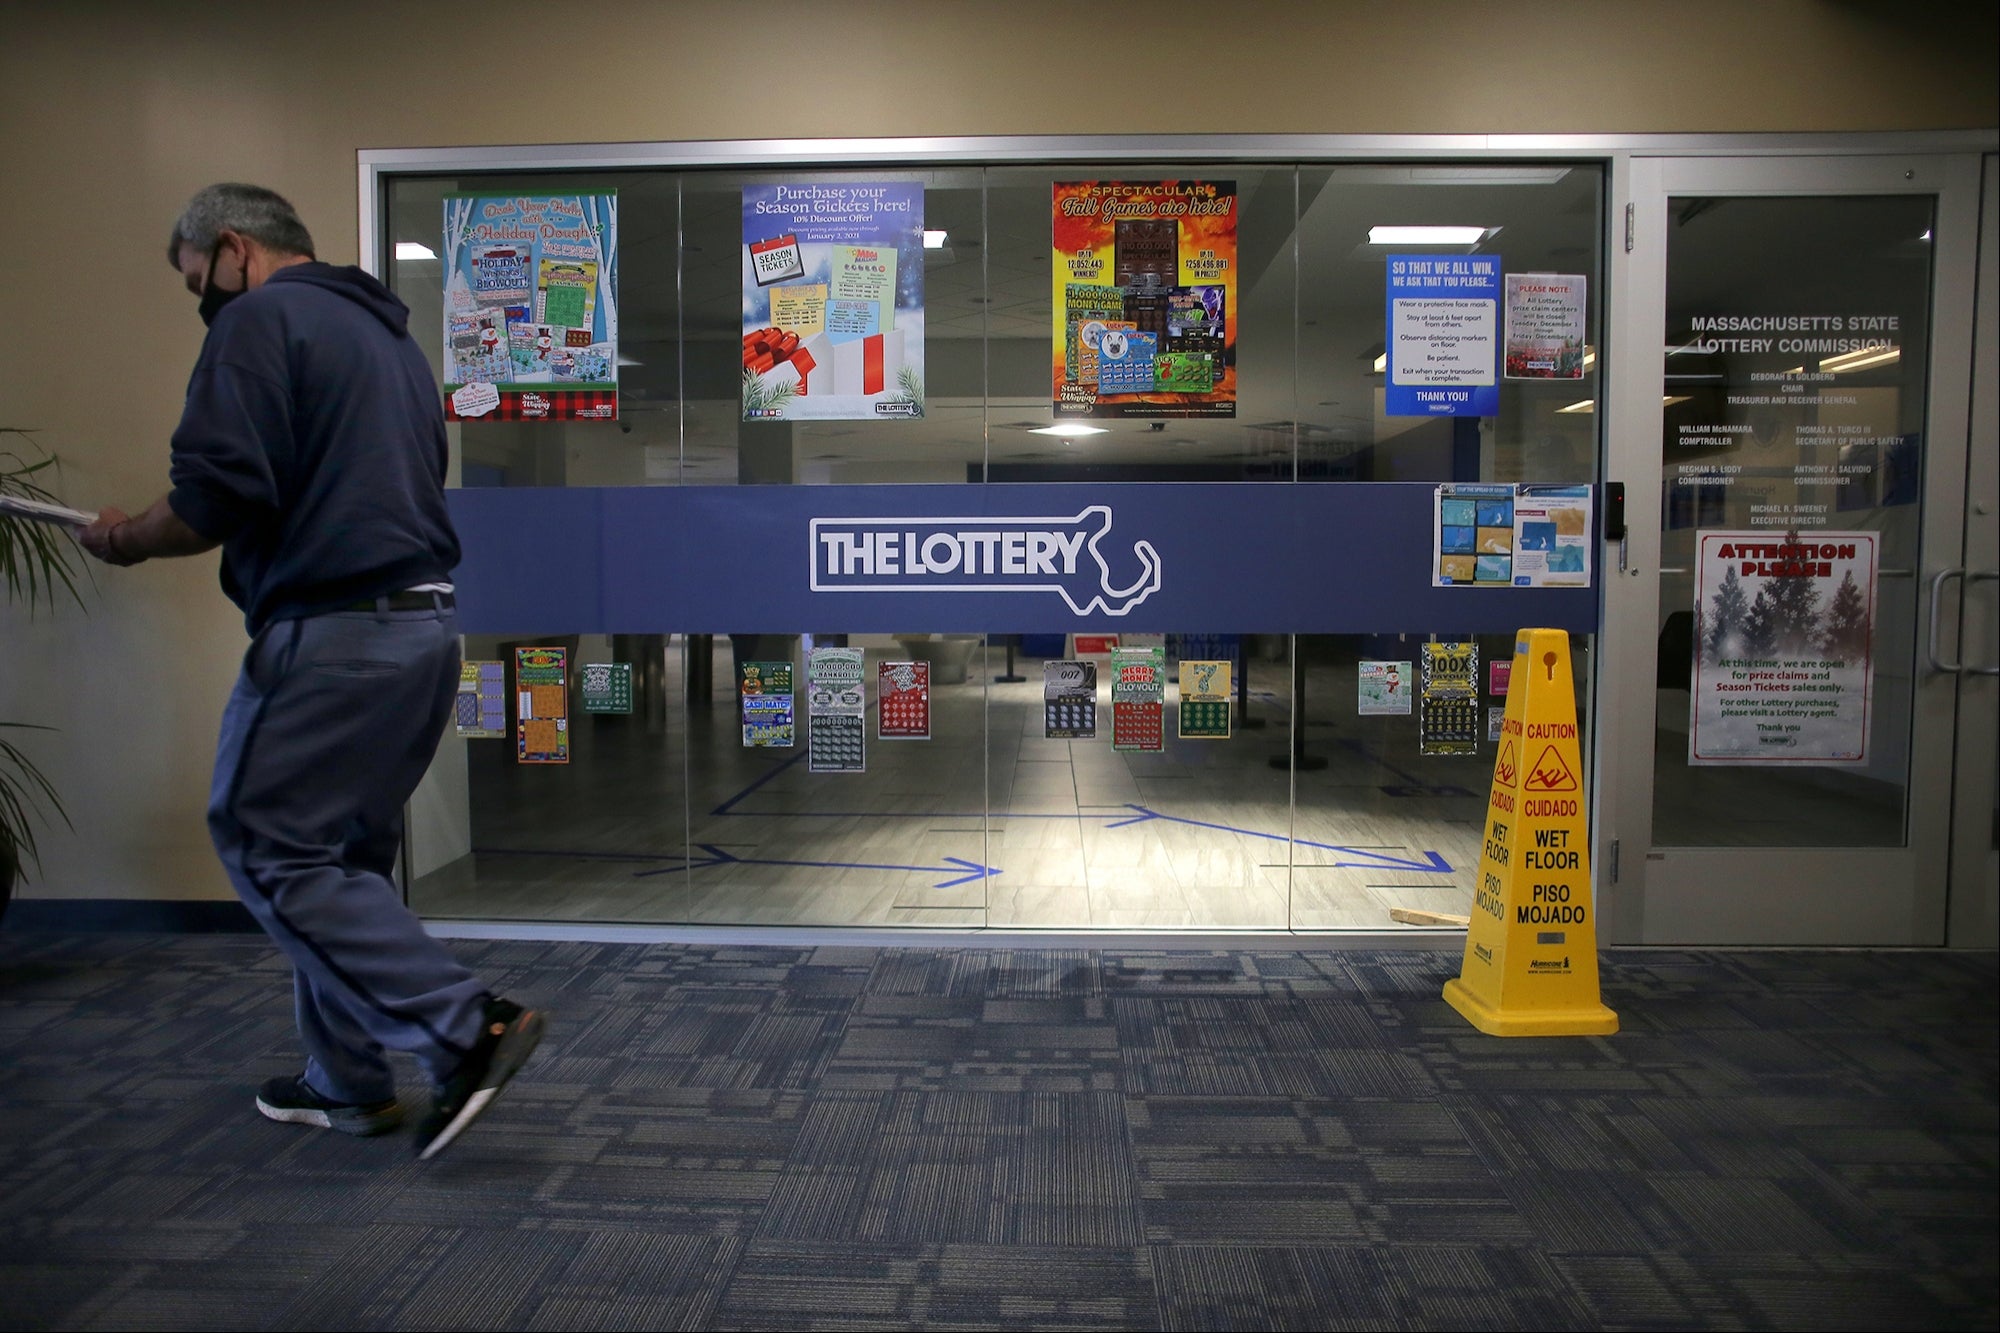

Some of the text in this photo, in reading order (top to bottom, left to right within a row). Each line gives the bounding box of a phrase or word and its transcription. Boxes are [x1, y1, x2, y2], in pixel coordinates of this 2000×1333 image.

[774, 186, 887, 203] Purchase your
[1093, 187, 1205, 196] SPECTACULAR
[756, 199, 911, 214] Season Tickets here!
[1062, 196, 1232, 224] Fall Games are here!
[811, 215, 847, 223] Discount
[478, 224, 590, 244] Holiday Dough
[479, 256, 524, 268] HOLIDAY
[759, 249, 792, 263] SEASON
[761, 258, 794, 272] TICKETS
[1393, 262, 1494, 276] SO THAT WE ALL WIN,
[477, 277, 529, 288] BLOWOUT!
[1393, 277, 1494, 287] WE ASK THAT YOU PLEASE...
[1068, 300, 1123, 310] MONEY GAME
[1692, 317, 1899, 331] MASSACHUSETTS STATE
[1698, 339, 1892, 353] LOTTERY COMMISSION
[1154, 356, 1178, 364] LUCKY
[1751, 373, 1835, 381] DEBORAH B. GOLDBERG
[1061, 393, 1096, 403] Winning
[1417, 392, 1468, 401] THANK YOU!
[1680, 425, 1753, 433] WILLIAM McNAMARA
[1751, 505, 1827, 513] MICHAEL SWEENEY
[820, 532, 1087, 575] THE LOTTERY
[1718, 544, 1855, 559] ATTENTION
[1742, 562, 1831, 577] PLEASE
[1121, 666, 1155, 675] MERRY
[1431, 657, 1470, 673] 100X
[1719, 659, 1730, 668] At
[1733, 659, 1749, 668] this
[1753, 659, 1780, 670] time,
[1819, 661, 1844, 670] open
[1061, 670, 1080, 679] 007
[1121, 674, 1154, 683] MONEY
[1732, 671, 1830, 682] for prize claims and
[1717, 683, 1844, 694] Season Tickets sales only.
[765, 701, 790, 709] MATCH
[1720, 699, 1839, 708] For other Lottery purchases,
[1721, 709, 1748, 718] please
[1750, 709, 1767, 717] visit
[1777, 709, 1807, 718] Lottery
[1810, 710, 1836, 718] agent.
[1502, 717, 1523, 737] CAUTION
[1527, 723, 1575, 739] CAUTION
[1785, 725, 1800, 733] you
[1491, 787, 1514, 813] CUIDADO
[1524, 800, 1577, 817] CUIDADO
[1492, 821, 1508, 843] WET
[1535, 830, 1569, 847] WET
[1485, 839, 1509, 867] FLOOR
[1525, 851, 1578, 869] FLOOR
[1484, 872, 1501, 896] PISO
[1533, 885, 1570, 902] PISO
[1476, 889, 1504, 921] MOJADO
[1517, 906, 1585, 924] MOJADO
